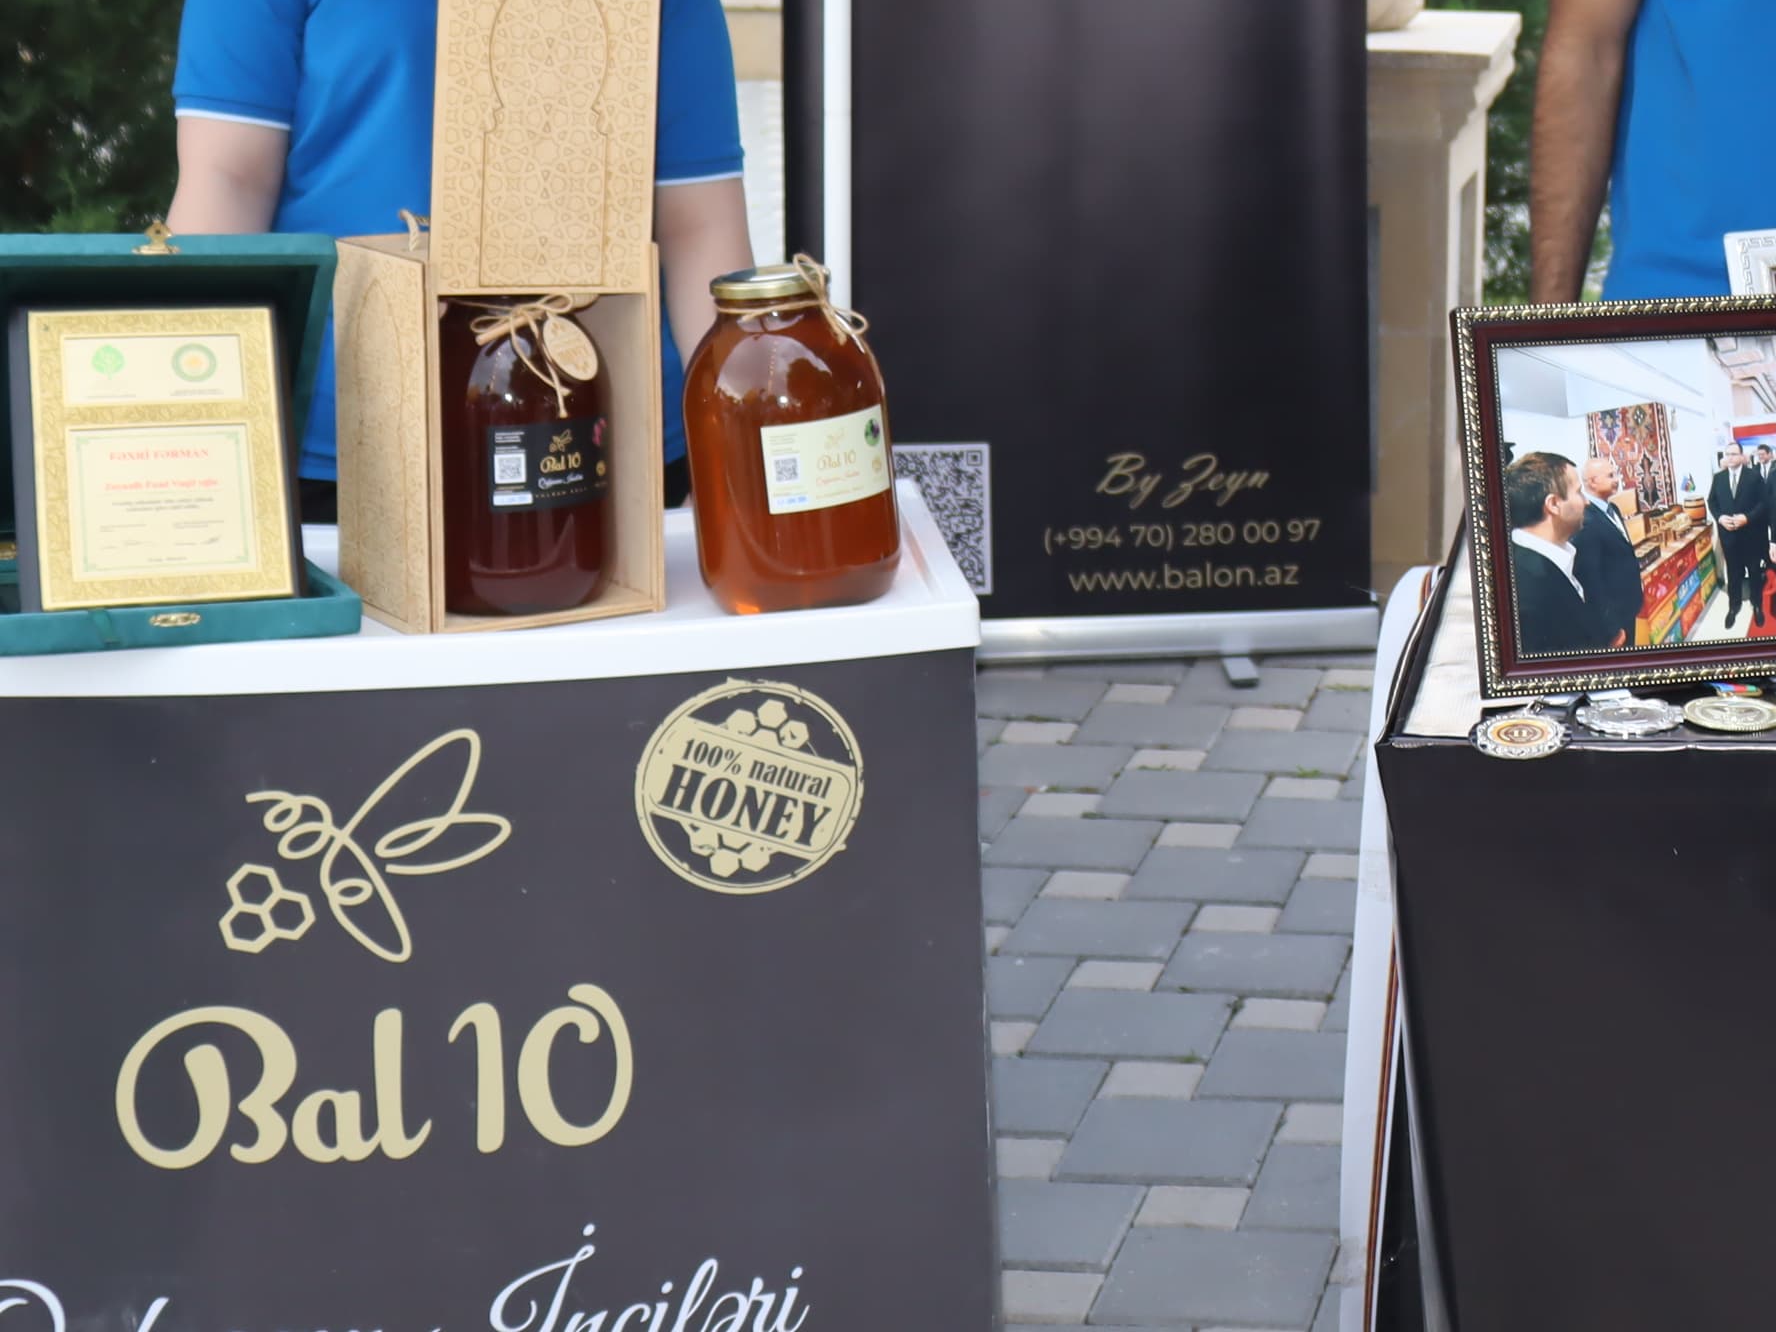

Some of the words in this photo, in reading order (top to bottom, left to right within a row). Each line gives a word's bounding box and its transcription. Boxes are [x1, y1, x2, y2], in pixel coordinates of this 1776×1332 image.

[540, 455, 566, 473] Bal
[568, 452, 581, 468] 10
[1097, 452, 1162, 509] By
[1162, 453, 1270, 509] Zeyn
[1044, 525, 1122, 554] (+994
[1130, 523, 1174, 552] 70)
[1183, 522, 1235, 547] 280
[1243, 521, 1280, 545] 00
[1286, 519, 1322, 543] 97
[1068, 562, 1300, 593] www.balon.az
[681, 738, 742, 776] 100%
[747, 759, 833, 800] natural
[657, 764, 833, 847] HONEY
[115, 1006, 432, 1169] Bal
[448, 983, 634, 1154] 10
